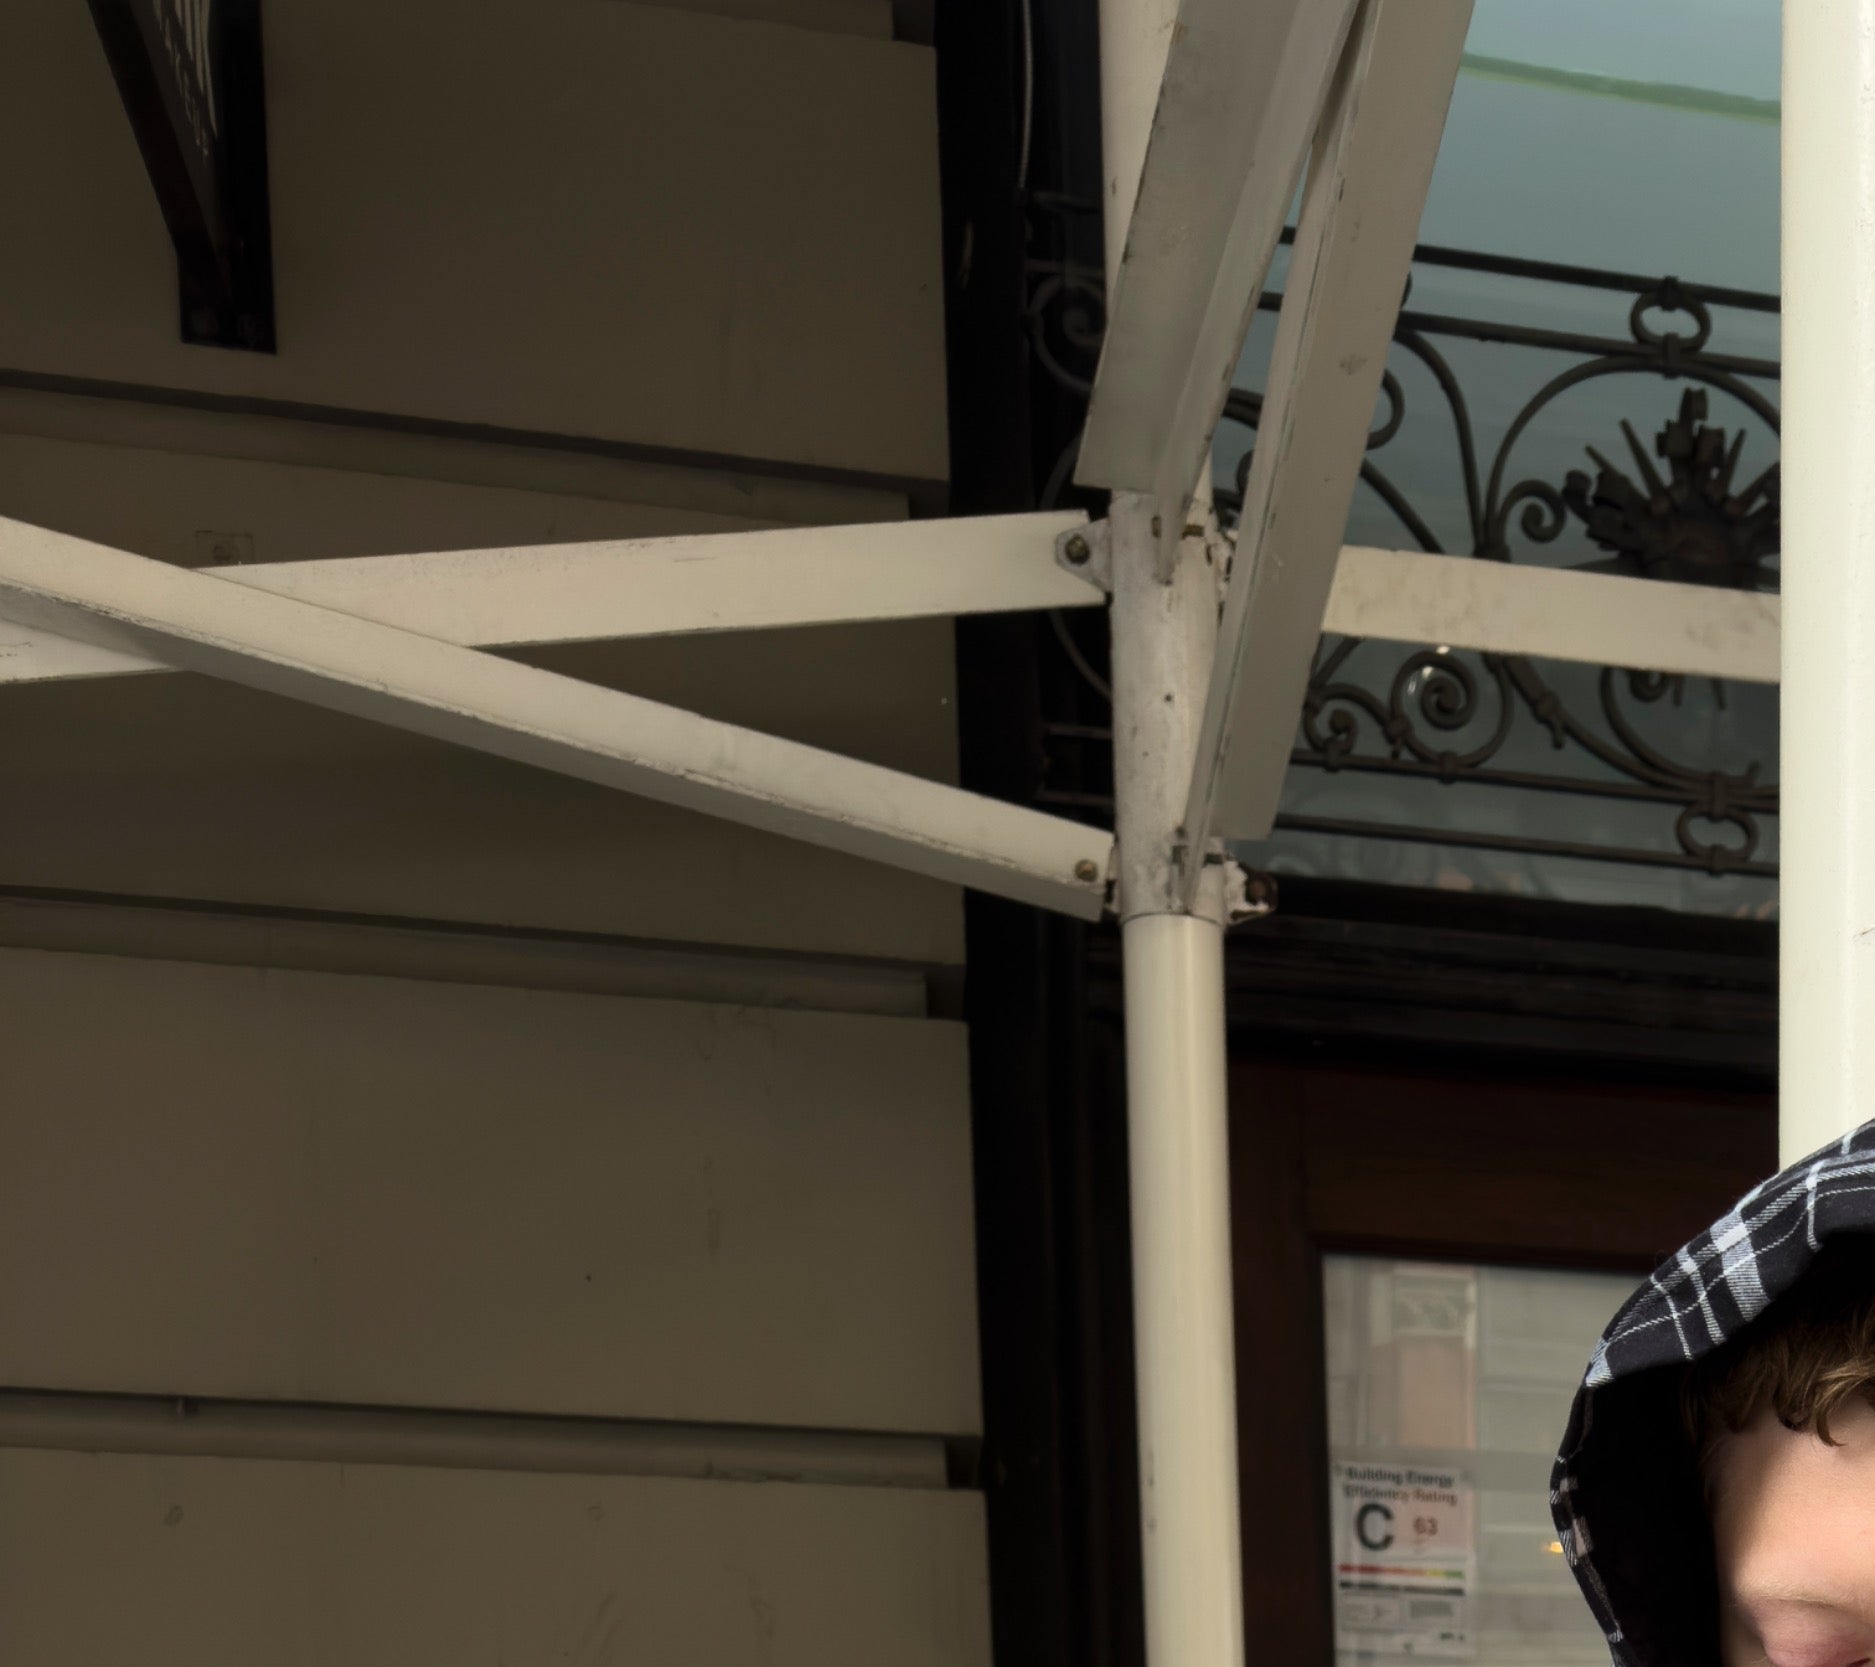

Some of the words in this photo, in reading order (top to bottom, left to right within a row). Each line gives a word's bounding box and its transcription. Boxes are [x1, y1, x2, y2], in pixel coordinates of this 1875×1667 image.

[1346, 1466, 1403, 1485] Building
[1406, 1470, 1454, 1488] Energy
[1355, 1502, 1394, 1551] C
